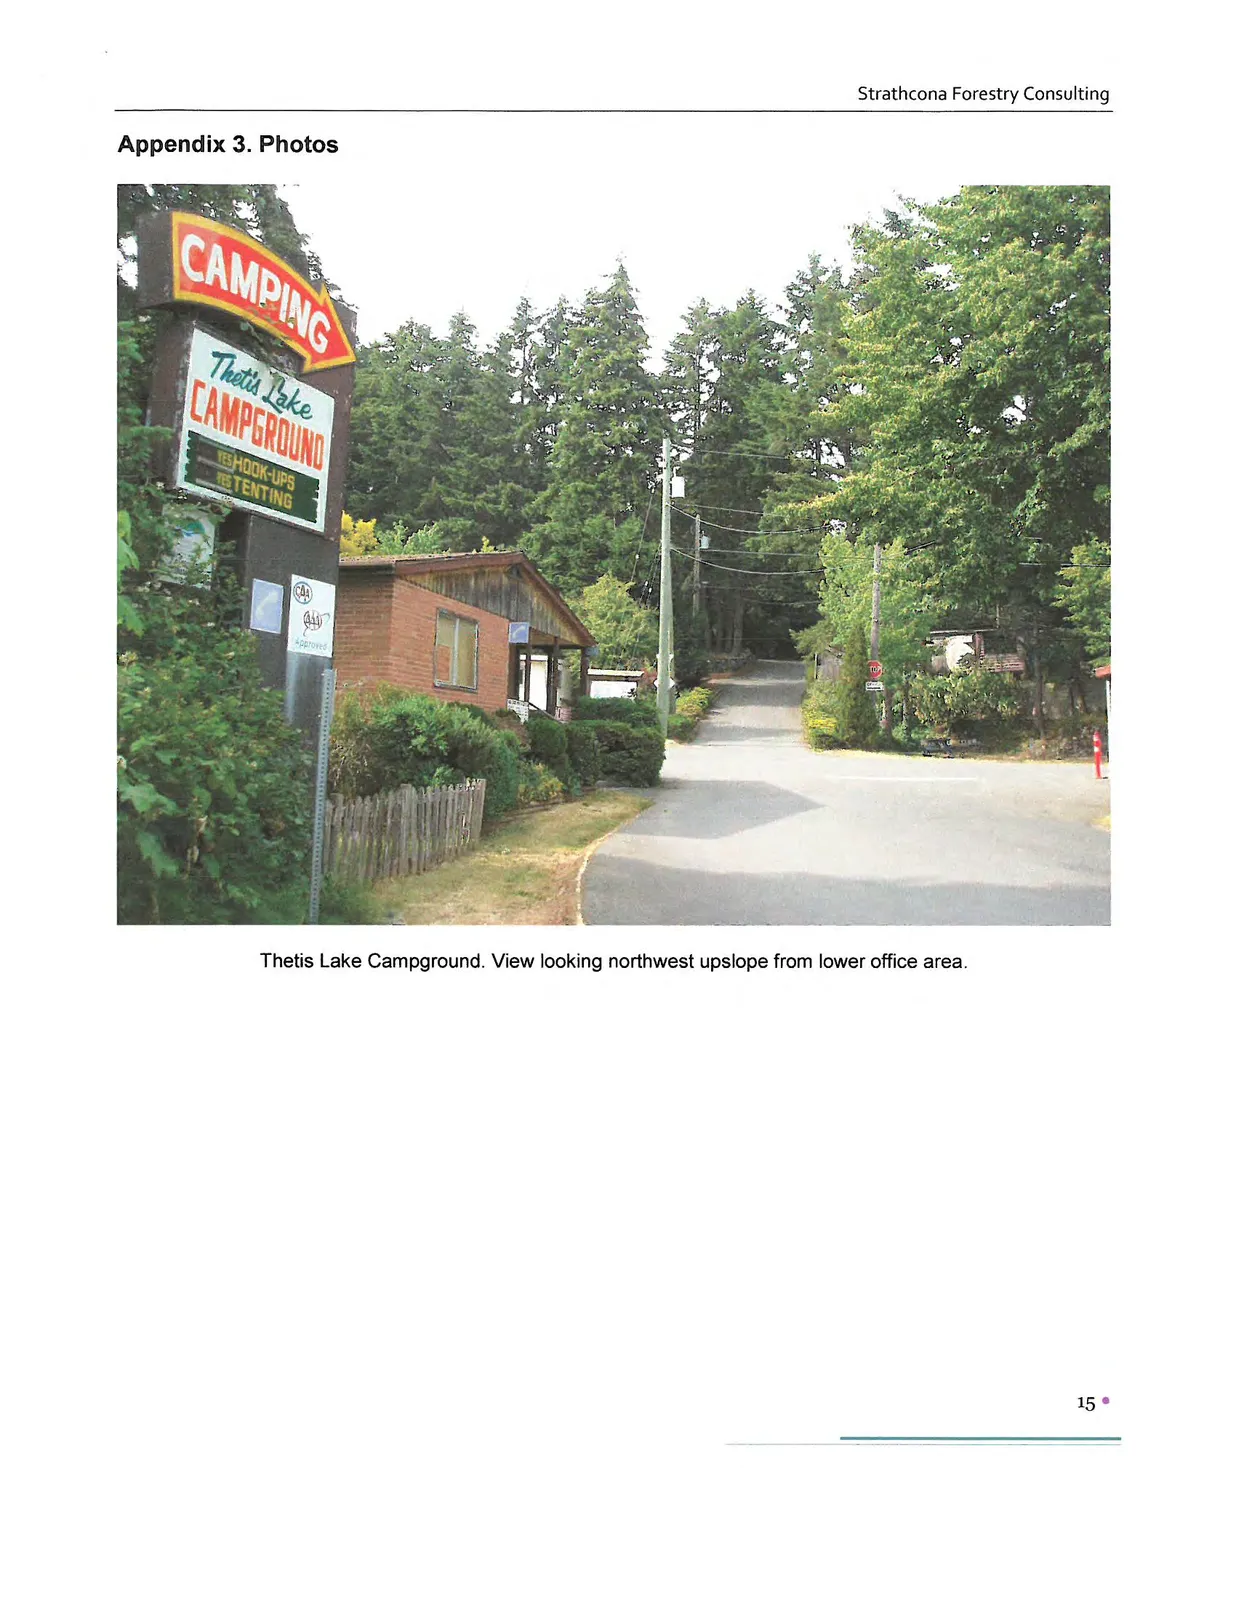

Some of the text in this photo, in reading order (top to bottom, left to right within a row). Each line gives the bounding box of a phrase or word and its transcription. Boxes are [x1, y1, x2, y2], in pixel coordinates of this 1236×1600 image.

[858, 85, 1110, 106] Strathcona Forestry Consulting
[117, 134, 339, 158] Appendix 3. Photos
[181, 233, 331, 354] CAMPING
[211, 351, 313, 420] Thetis Lake
[190, 378, 325, 471] CAMPGROUND
[217, 450, 296, 491] YES HOOK-UPS
[232, 475, 293, 510] TENTING
[295, 638, 328, 650] Approved
[259, 952, 968, 973] Thetis Lake Campground. View looking northwest upslope from lower office area.
[1077, 1396, 1096, 1412] 15
